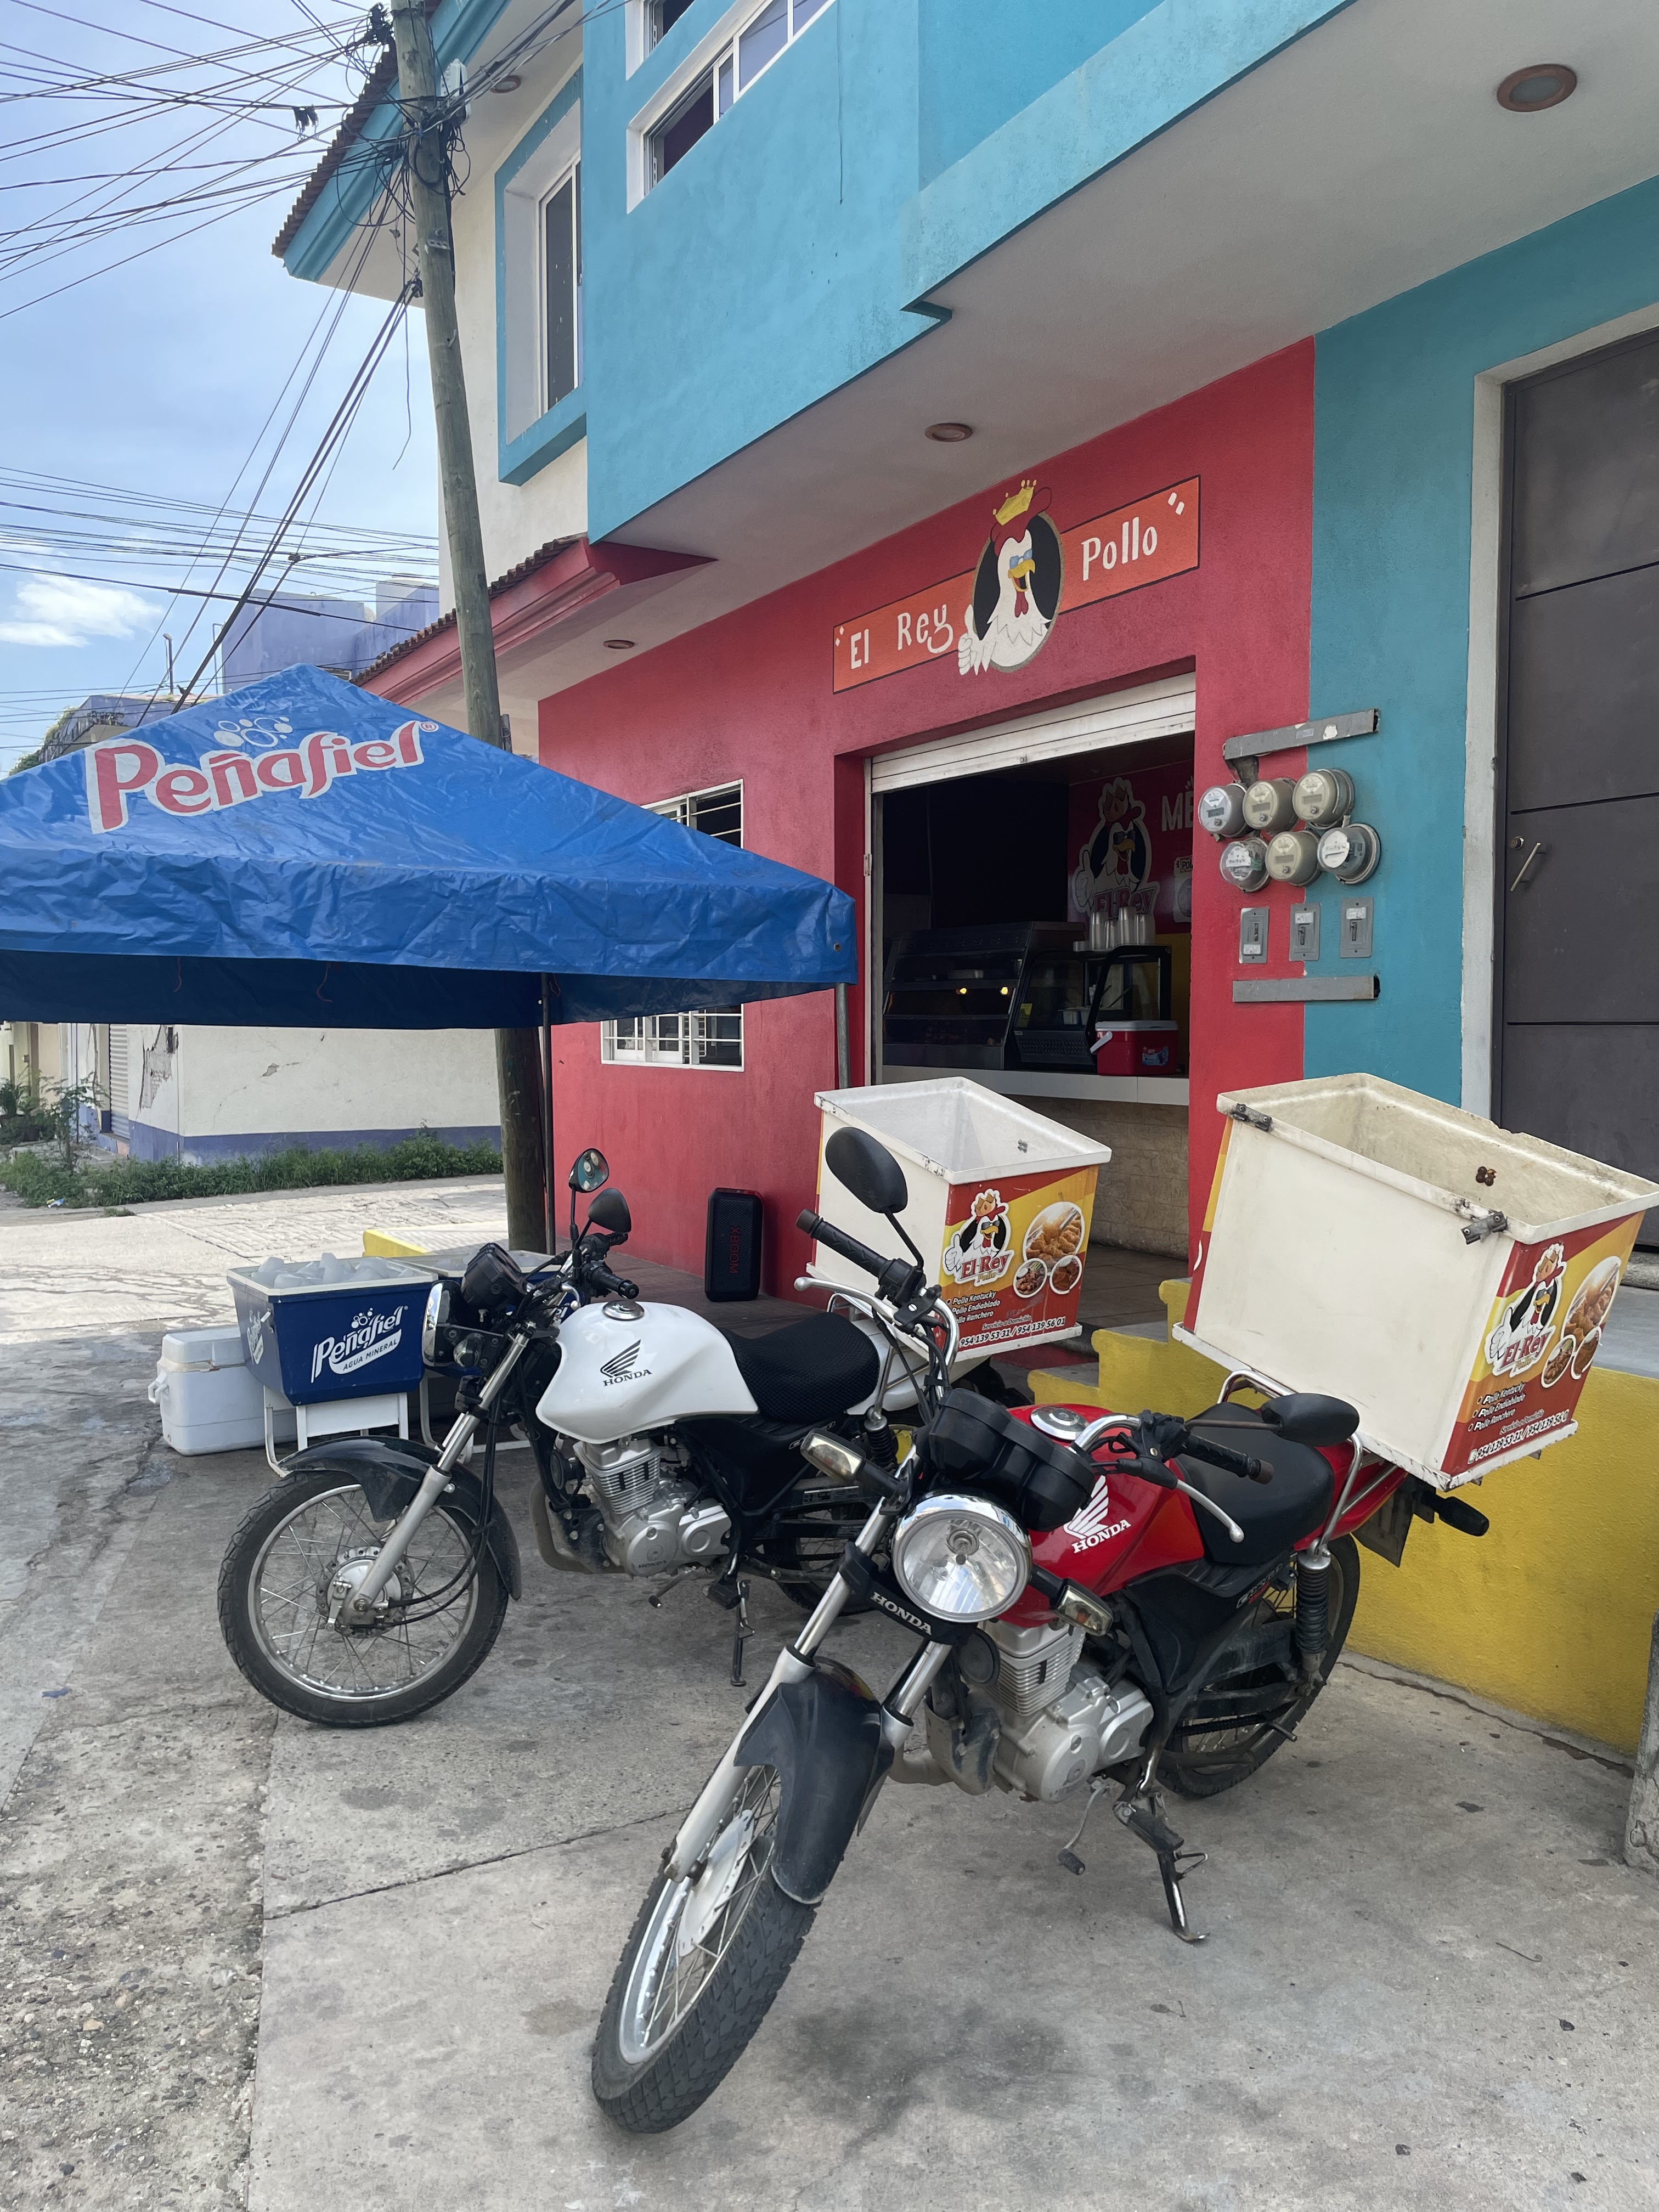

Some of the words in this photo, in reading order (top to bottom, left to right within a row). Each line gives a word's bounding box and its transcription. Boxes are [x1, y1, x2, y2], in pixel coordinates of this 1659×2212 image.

[850, 628, 870, 670] El
[896, 603, 954, 654] Rey
[1080, 516, 1159, 582] Pollo
[88, 720, 422, 833] Peñafiel
[729, 1226, 741, 1274] XBOOM
[952, 1295, 969, 1305] Pollo
[969, 1290, 997, 1302] Kentucky
[967, 1299, 1001, 1312] Endiablado
[960, 1336, 974, 1347] 954
[975, 1333, 990, 1344] 139
[990, 1331, 1000, 1340] 53
[1001, 1329, 1010, 1338] 31
[1017, 1324, 1031, 1335] 954
[1031, 1321, 1046, 1331] 139
[1047, 1318, 1056, 1328] 56
[1056, 1317, 1066, 1326] 01
[966, 1311, 994, 1322] Ranchero
[311, 1305, 404, 1384] Peñafiel
[342, 1356, 364, 1371] AGUA
[365, 1339, 398, 1360] MINERAL
[602, 1369, 653, 1387] HONDA
[1475, 1443, 1491, 1460] 954
[1503, 1433, 1514, 1448] 53
[1071, 1519, 1132, 1554] HONDA
[870, 1591, 932, 1636] HONDA
